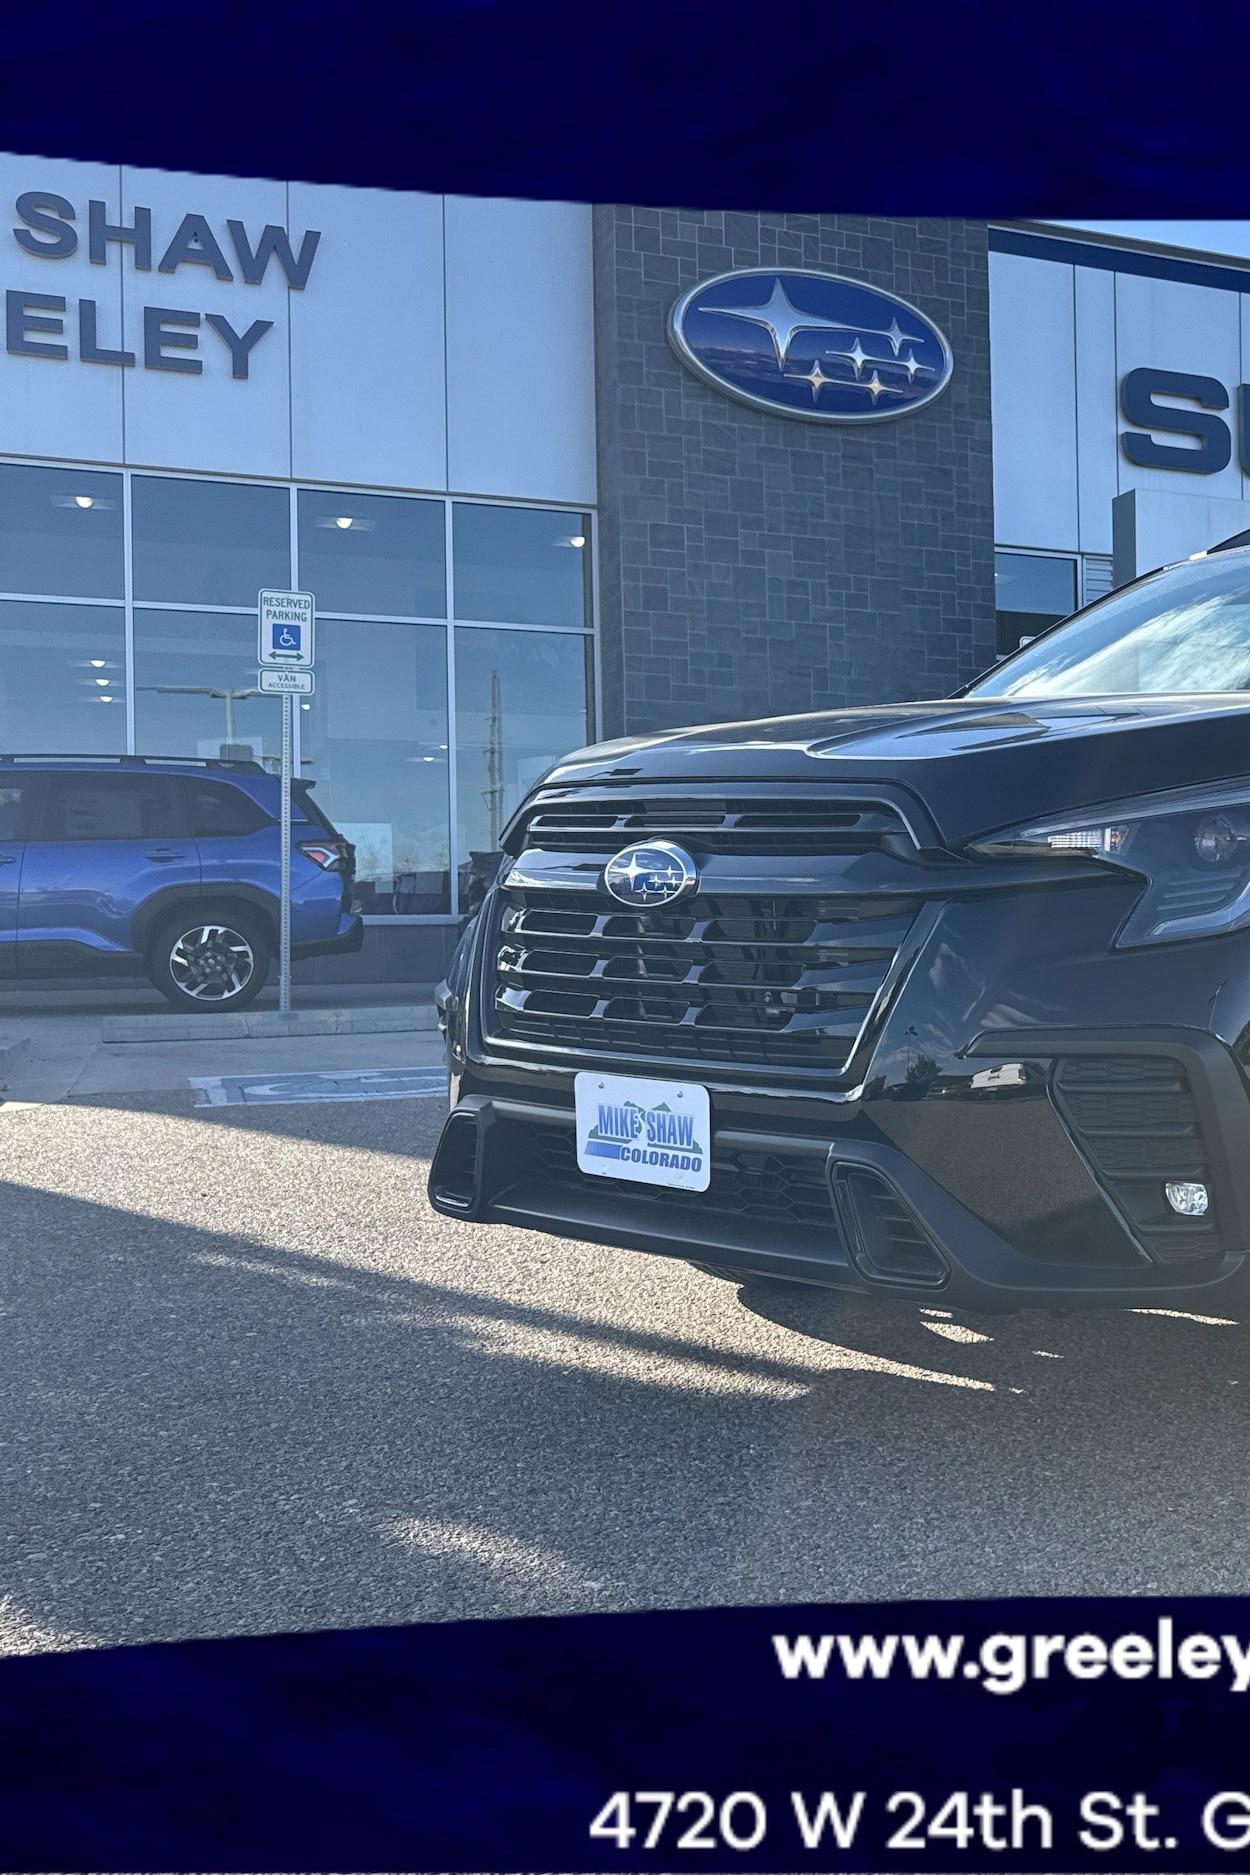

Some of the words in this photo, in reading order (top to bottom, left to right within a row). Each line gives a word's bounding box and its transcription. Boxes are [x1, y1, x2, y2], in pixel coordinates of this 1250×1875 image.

[13, 191, 321, 291] SHAW
[5, 290, 274, 380] ELEY
[264, 597, 310, 609] RESERVED
[267, 610, 307, 622] PARKING
[268, 682, 305, 690] ACCESSIBLE
[598, 1105, 638, 1138] MIKE
[646, 1110, 694, 1147] SHAW
[620, 1147, 702, 1172] COLORADO
